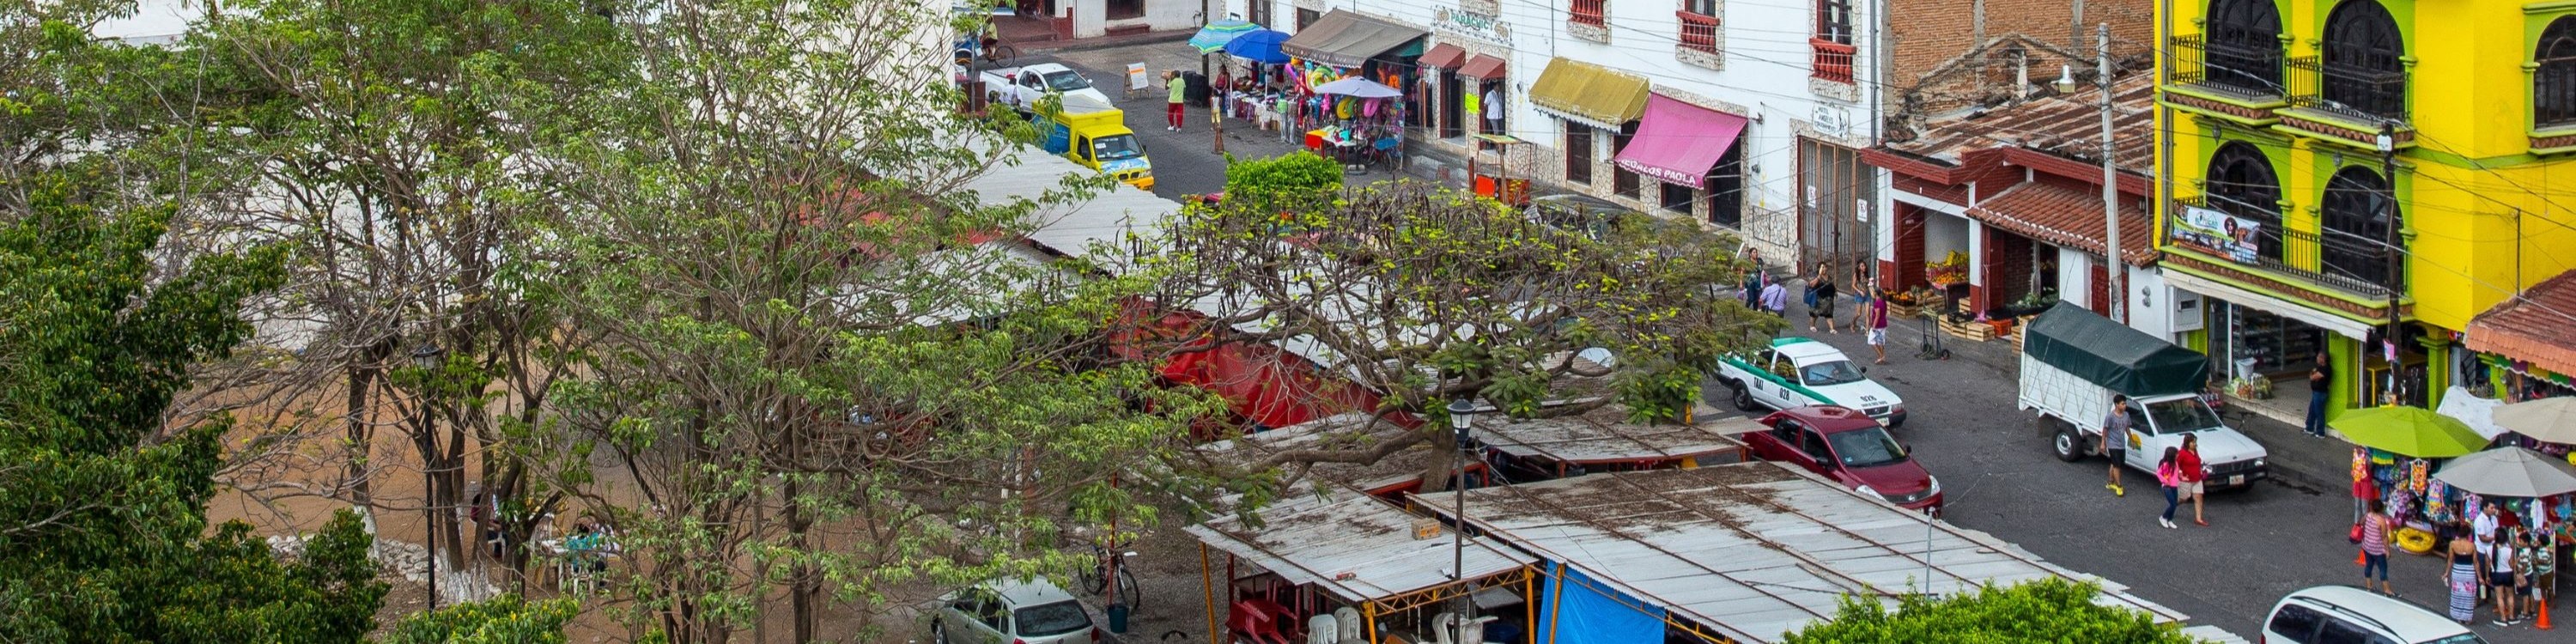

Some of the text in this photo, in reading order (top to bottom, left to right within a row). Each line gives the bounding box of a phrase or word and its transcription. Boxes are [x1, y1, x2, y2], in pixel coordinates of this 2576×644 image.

[1664, 170, 1696, 184] PAOLA
[1753, 377, 1763, 391] TAXI
[1779, 387, 1789, 401] 028
